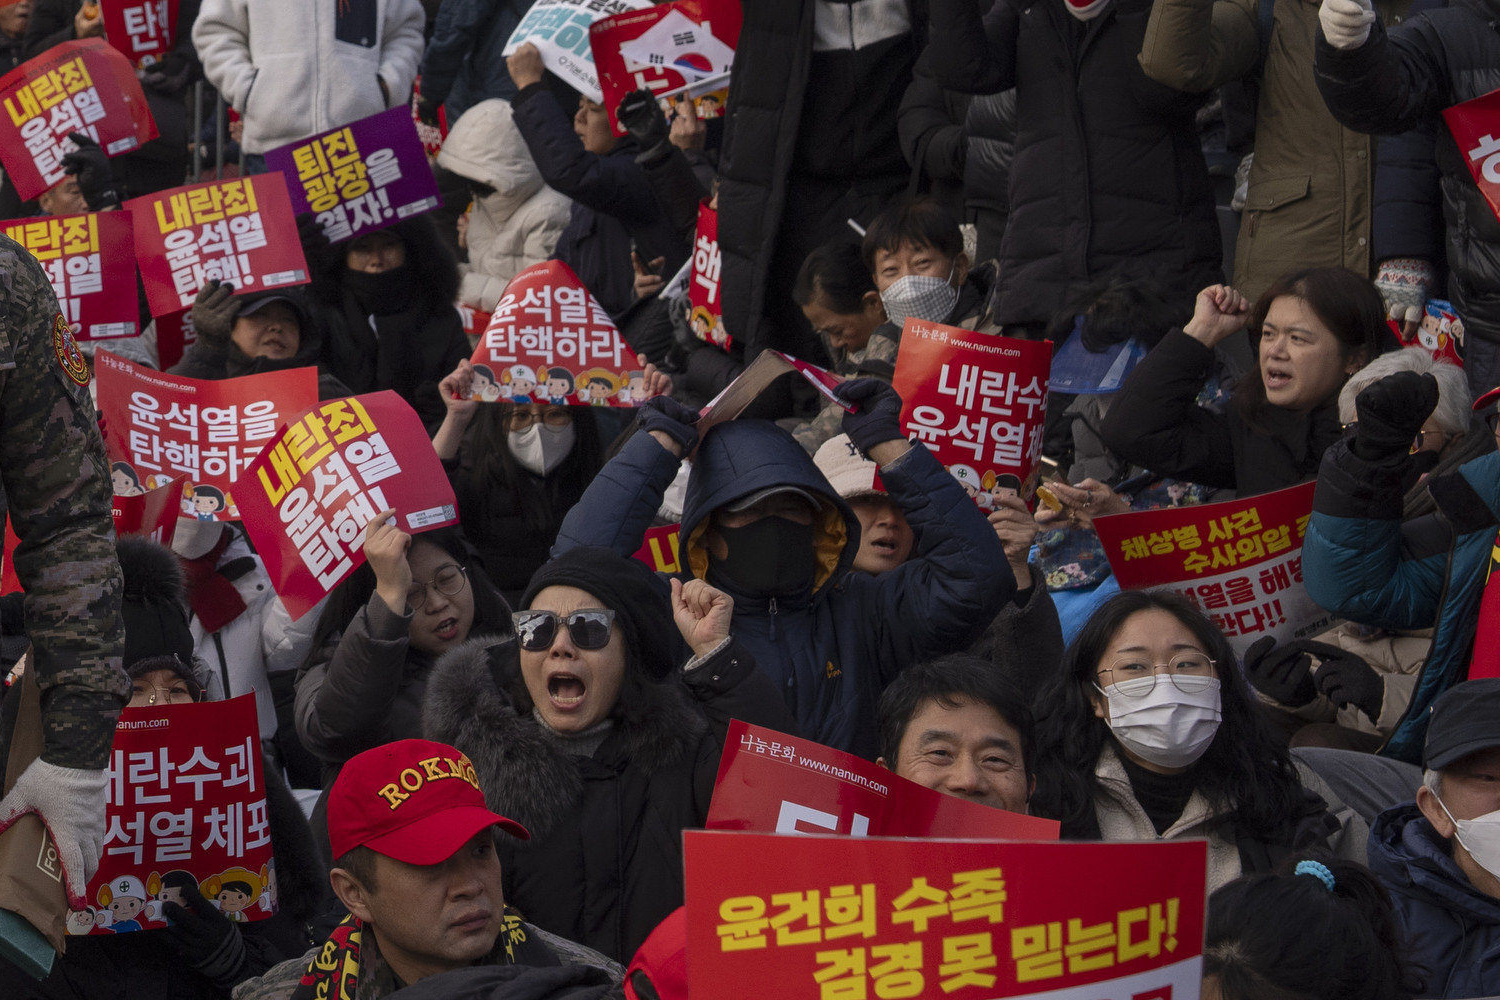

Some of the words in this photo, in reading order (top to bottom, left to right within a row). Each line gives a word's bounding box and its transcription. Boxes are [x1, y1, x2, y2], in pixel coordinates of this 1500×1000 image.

[3, 57, 92, 128] 내란죄
[20, 87, 107, 156] 윤석열
[292, 126, 362, 181] 퇴진
[305, 146, 403, 215] 광장을
[153, 177, 260, 235] 내란죄
[315, 195, 396, 244] 열자!
[162, 212, 268, 268] 윤석열
[171, 253, 255, 309] 탄핵!
[493, 284, 616, 326] 윤석열을
[485, 325, 627, 369] 탄핵하라
[949, 336, 1022, 360] www.nanum.com
[134, 371, 197, 393] www.nanum.com
[127, 391, 280, 443] 윤석열을
[906, 406, 1024, 467] 윤석열
[255, 396, 378, 508] 내란죄
[278, 431, 402, 549] 윤석열
[299, 484, 398, 592] 탄핵!
[1121, 524, 1203, 562] 채상병
[1207, 506, 1263, 543] 사건
[1182, 524, 1293, 574] 수사외압
[739, 732, 798, 764] 나눔문화
[798, 754, 889, 797] www.nanum.com
[200, 798, 272, 859] 체포
[715, 883, 878, 953] 윤건희
[890, 867, 1008, 934] 수족
[812, 941, 925, 1000] 검경
[938, 932, 998, 994] 못
[1010, 898, 1182, 984] 믿는다!
